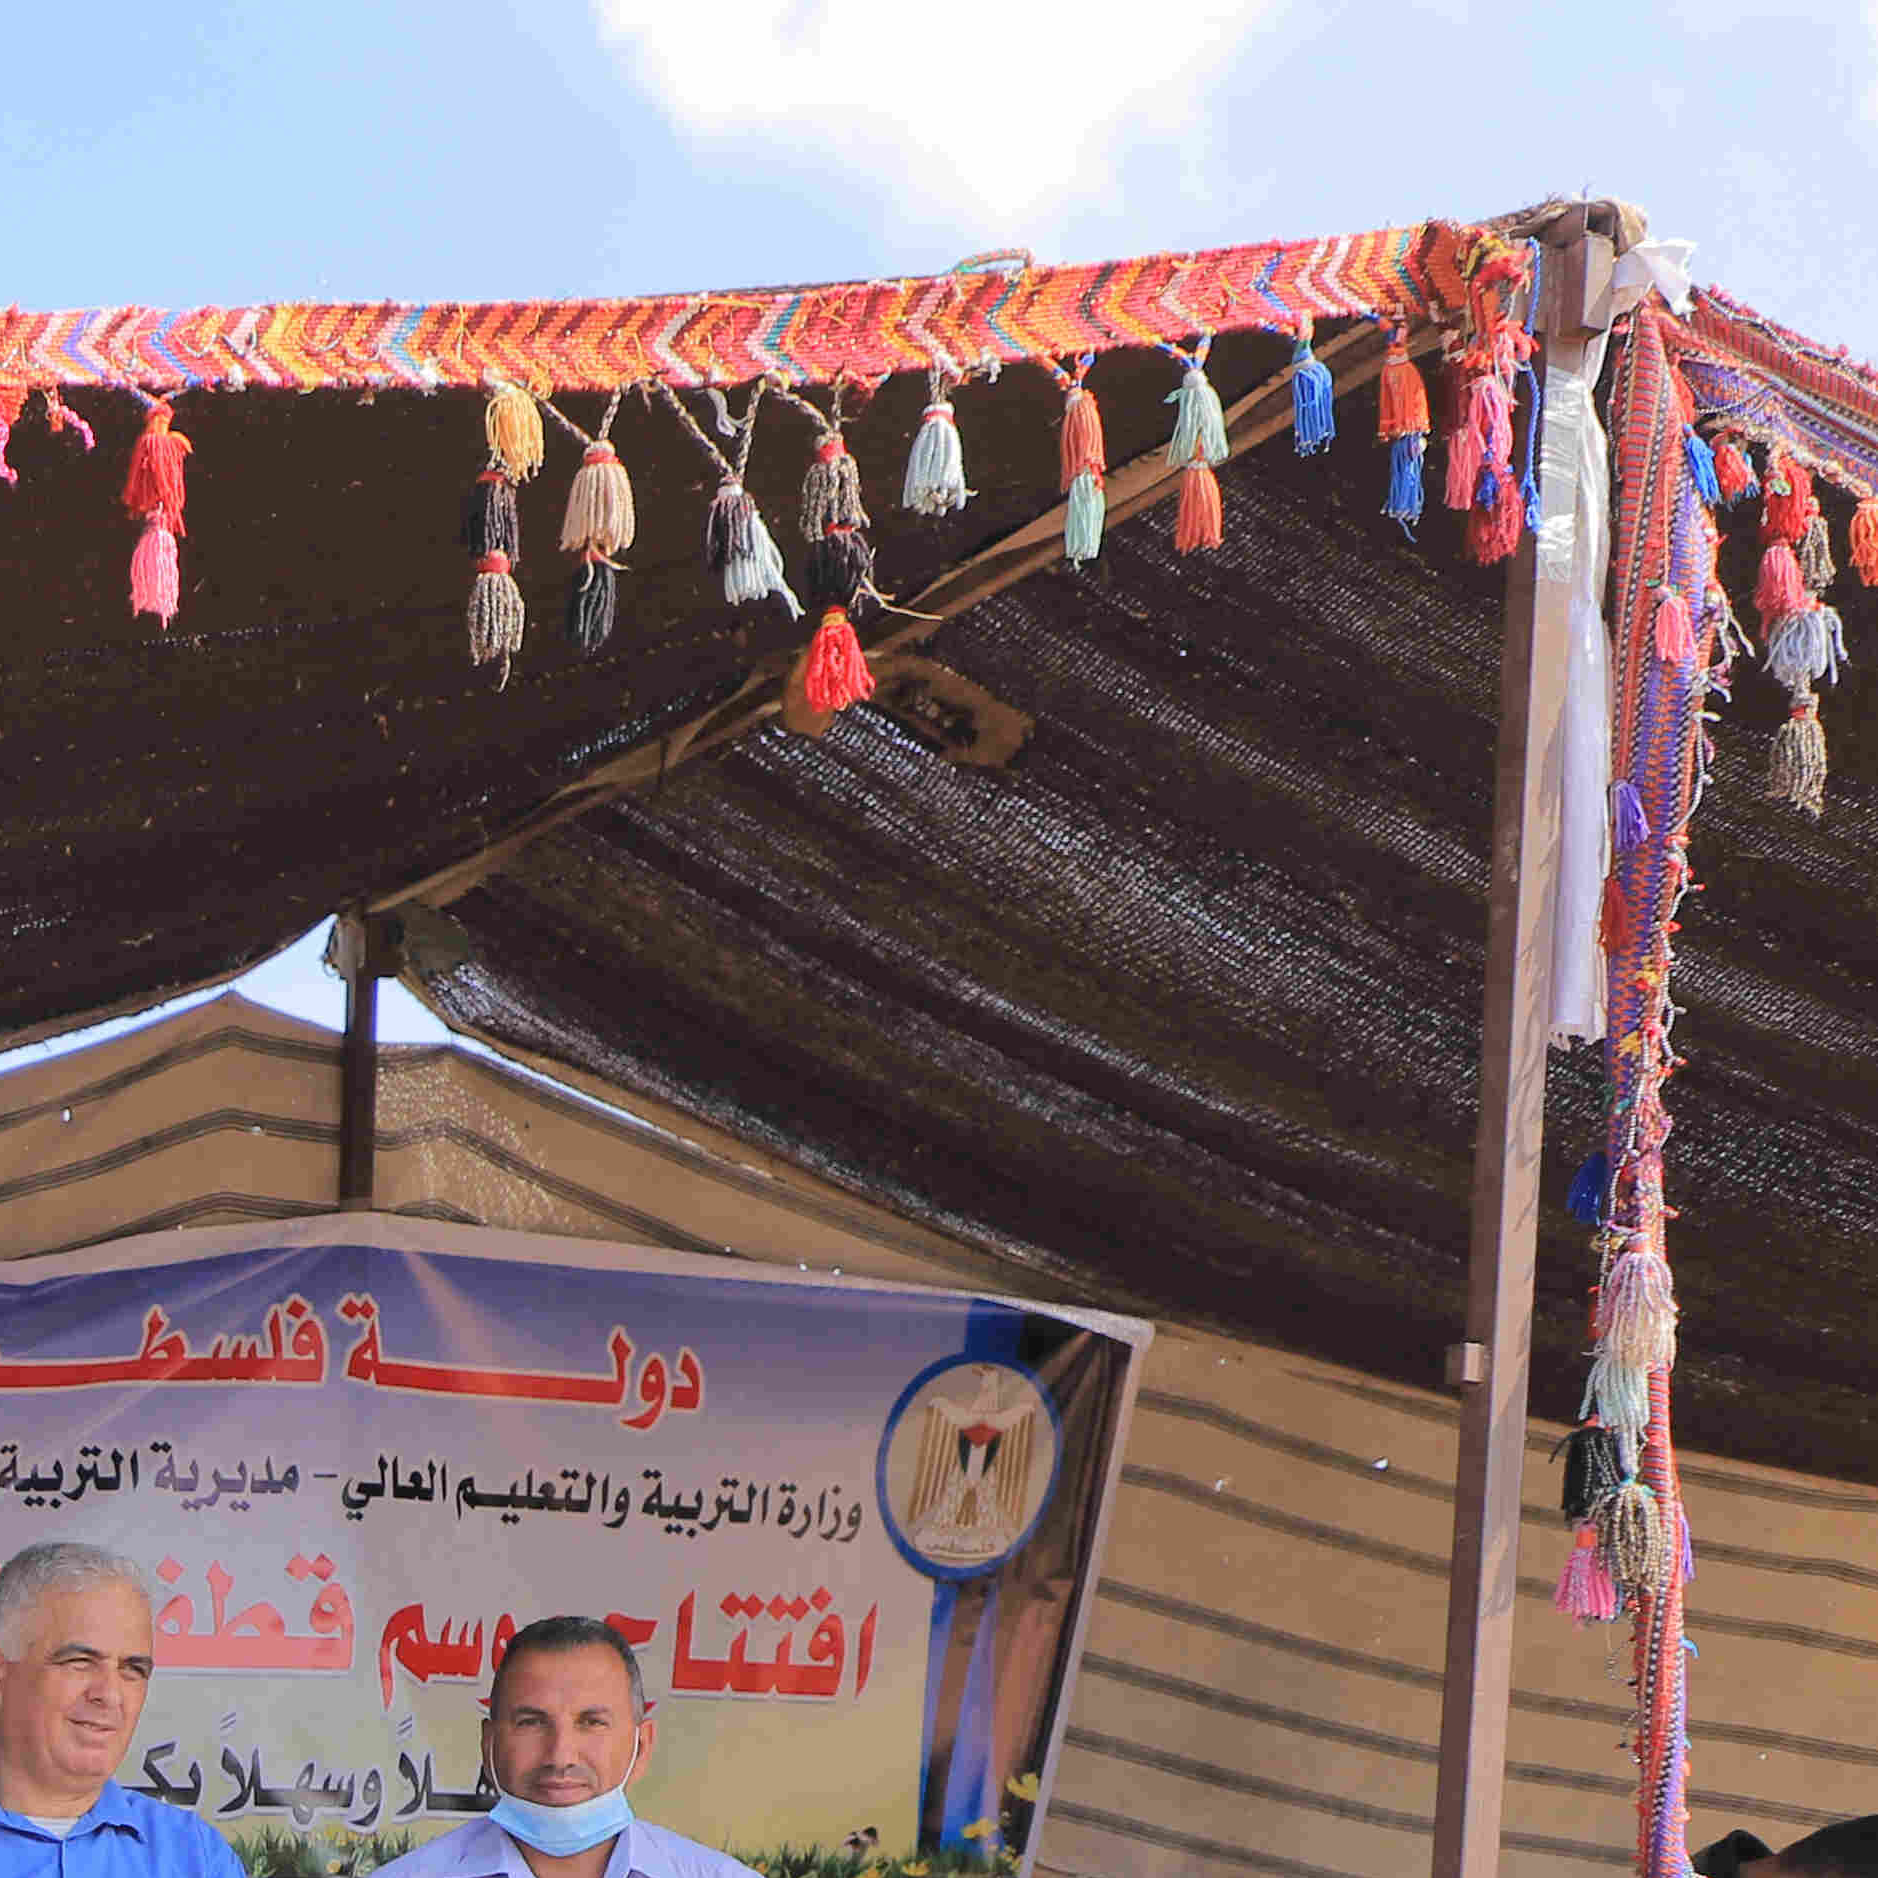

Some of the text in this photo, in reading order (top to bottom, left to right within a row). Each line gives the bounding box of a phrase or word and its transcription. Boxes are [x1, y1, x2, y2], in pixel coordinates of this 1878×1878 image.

[153, 1442, 300, 1511] مديرية
[455, 1470, 630, 1528] والتعليم
[641, 1470, 770, 1538] التربية
[778, 1483, 864, 1543] وزارة
